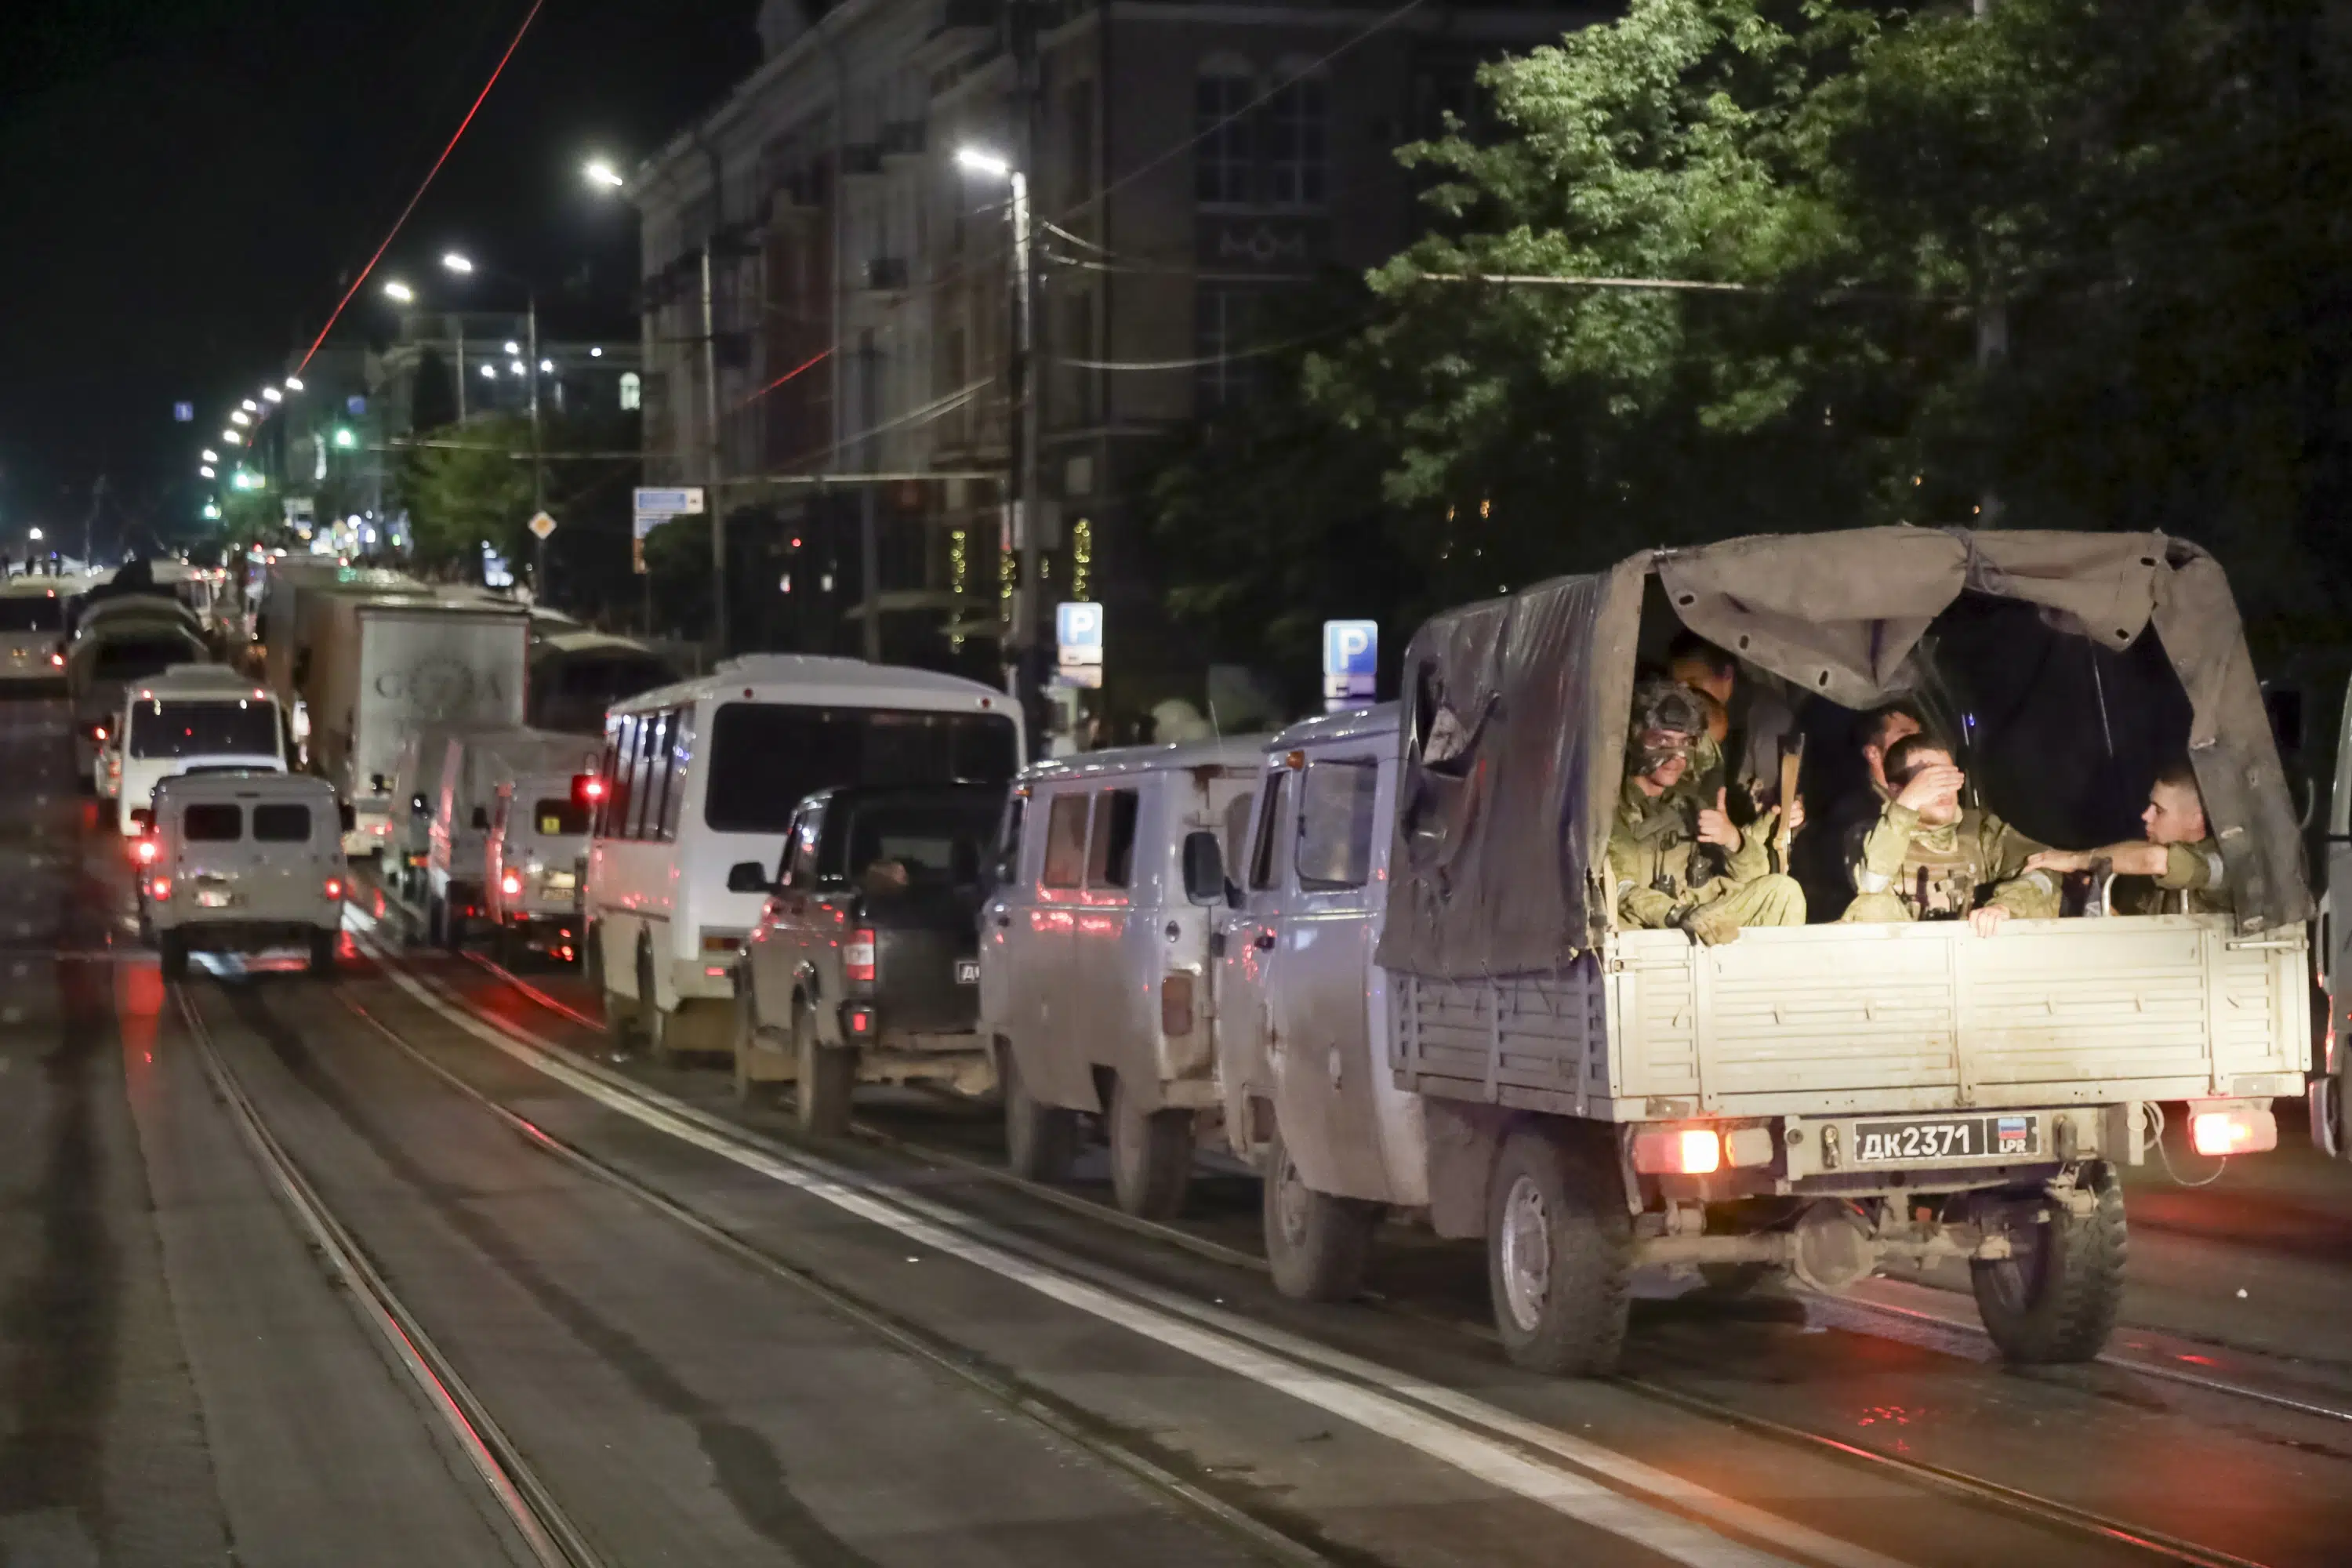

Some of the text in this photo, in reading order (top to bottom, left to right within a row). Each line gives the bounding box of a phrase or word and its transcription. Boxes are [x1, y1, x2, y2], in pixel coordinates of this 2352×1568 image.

[1069, 611, 1094, 644] P
[1340, 629, 1368, 670] P
[1862, 1124, 1970, 1160] ДК2371
[1998, 1139, 2027, 1153] LPR
